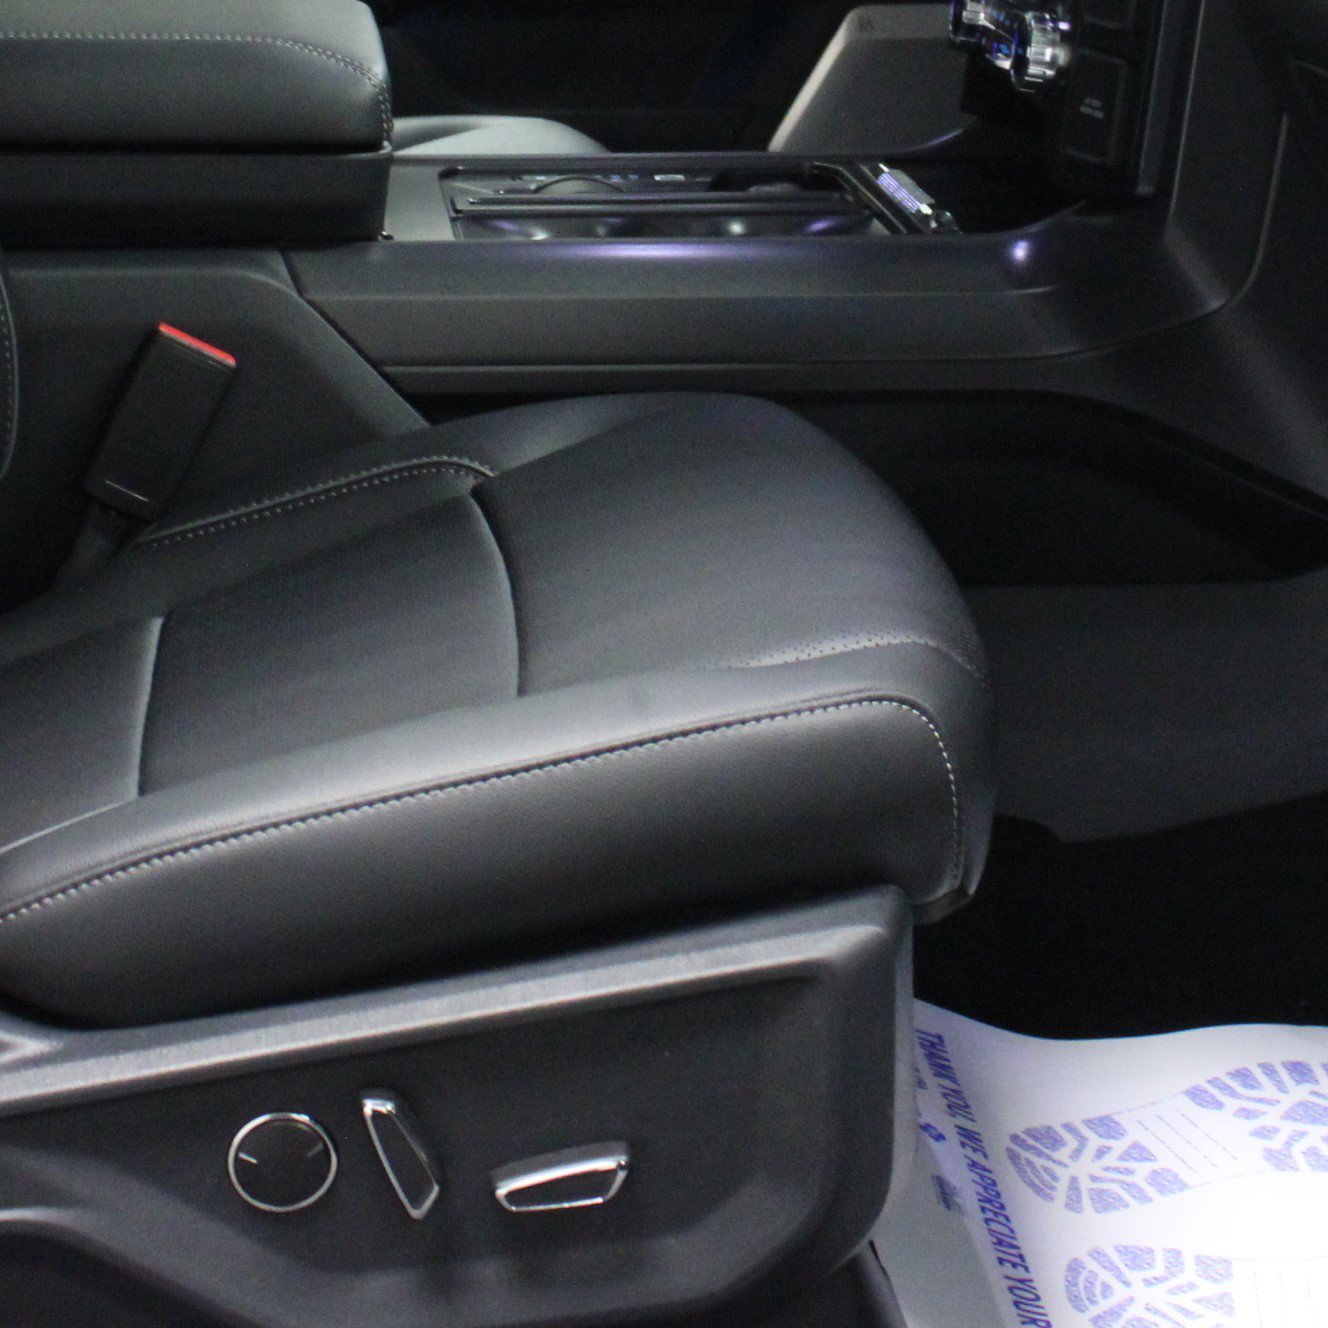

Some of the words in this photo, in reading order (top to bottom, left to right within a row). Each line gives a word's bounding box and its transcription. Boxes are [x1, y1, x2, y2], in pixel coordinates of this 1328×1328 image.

[915, 1029, 960, 1086] THANK
[953, 1124, 989, 1160] WE
[964, 1154, 1031, 1274] APPRECIATE
[1004, 1275, 1053, 1328] YOUR
